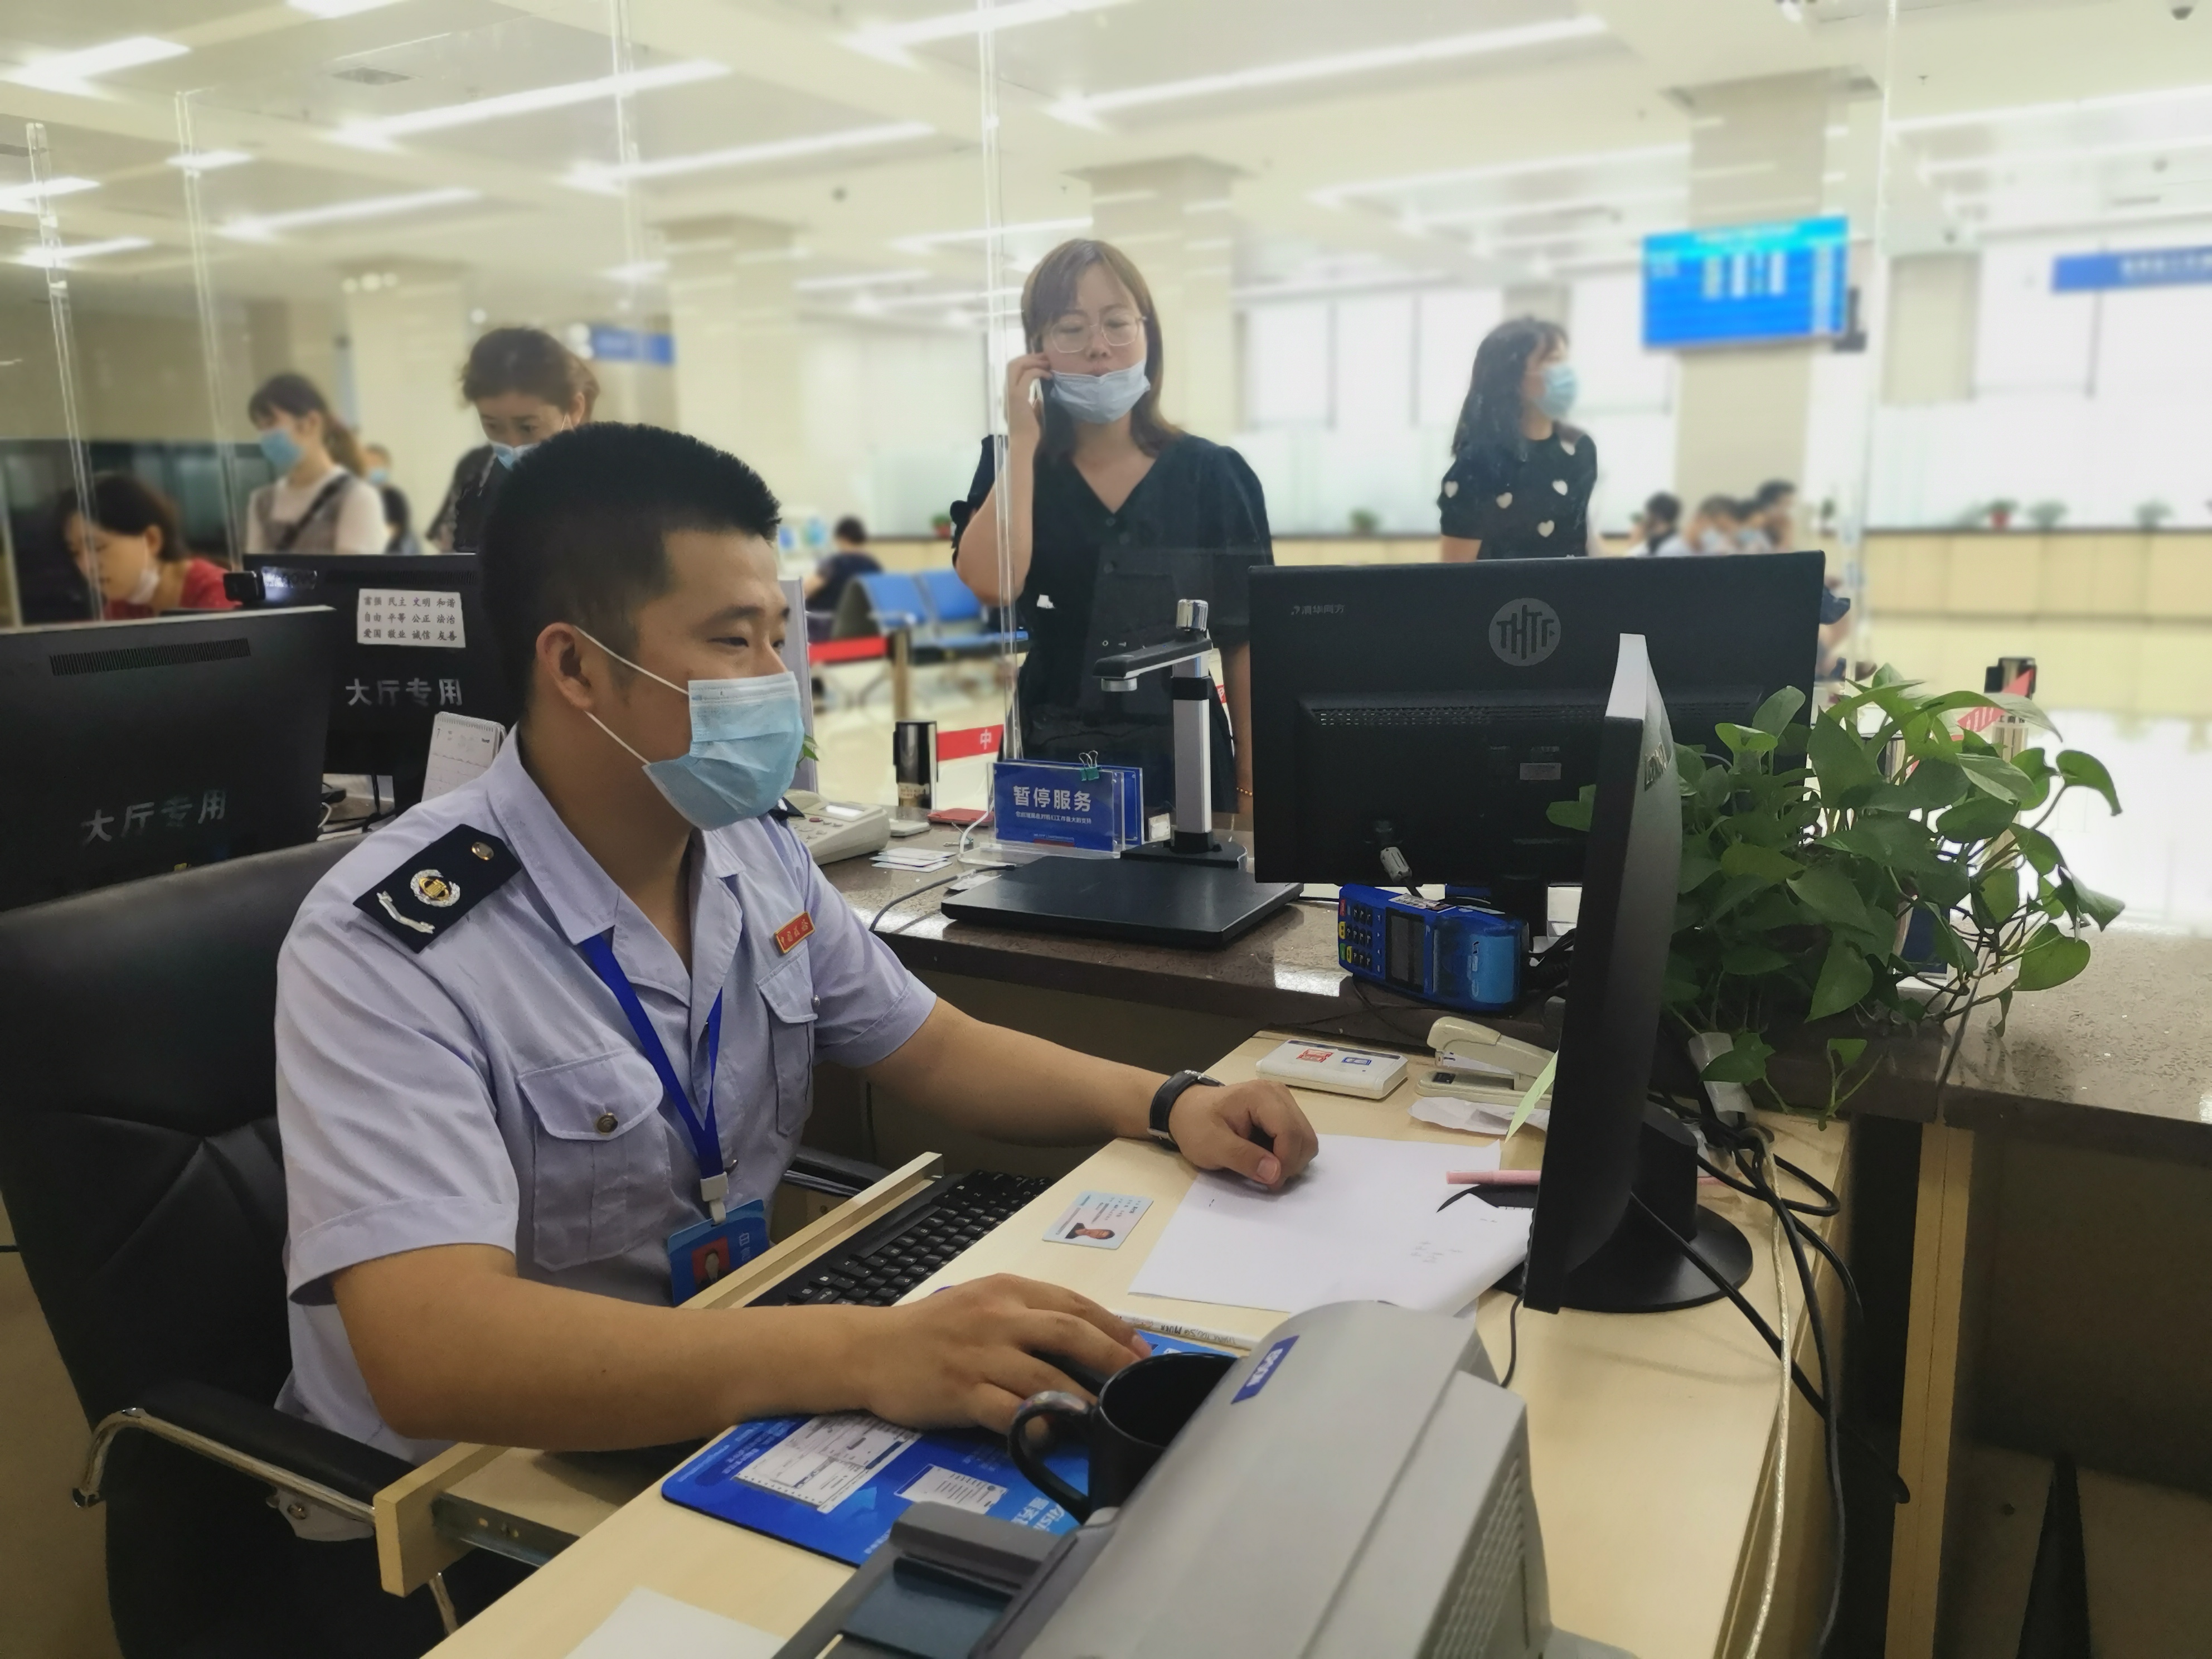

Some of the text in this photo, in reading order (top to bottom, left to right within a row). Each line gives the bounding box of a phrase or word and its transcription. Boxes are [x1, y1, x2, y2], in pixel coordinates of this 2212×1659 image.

[363, 596, 456, 608] 富强 民主 文明 和谐
[364, 612, 455, 624] 自由 平等 公正 法治
[363, 628, 381, 638] 爱国
[387, 629, 406, 639] 敬业
[437, 630, 457, 641] 友善
[345, 677, 463, 706] 大厅专用
[979, 728, 992, 751] 中
[1013, 785, 1092, 812] 暂停服务
[81, 789, 226, 845] 大厅专用
